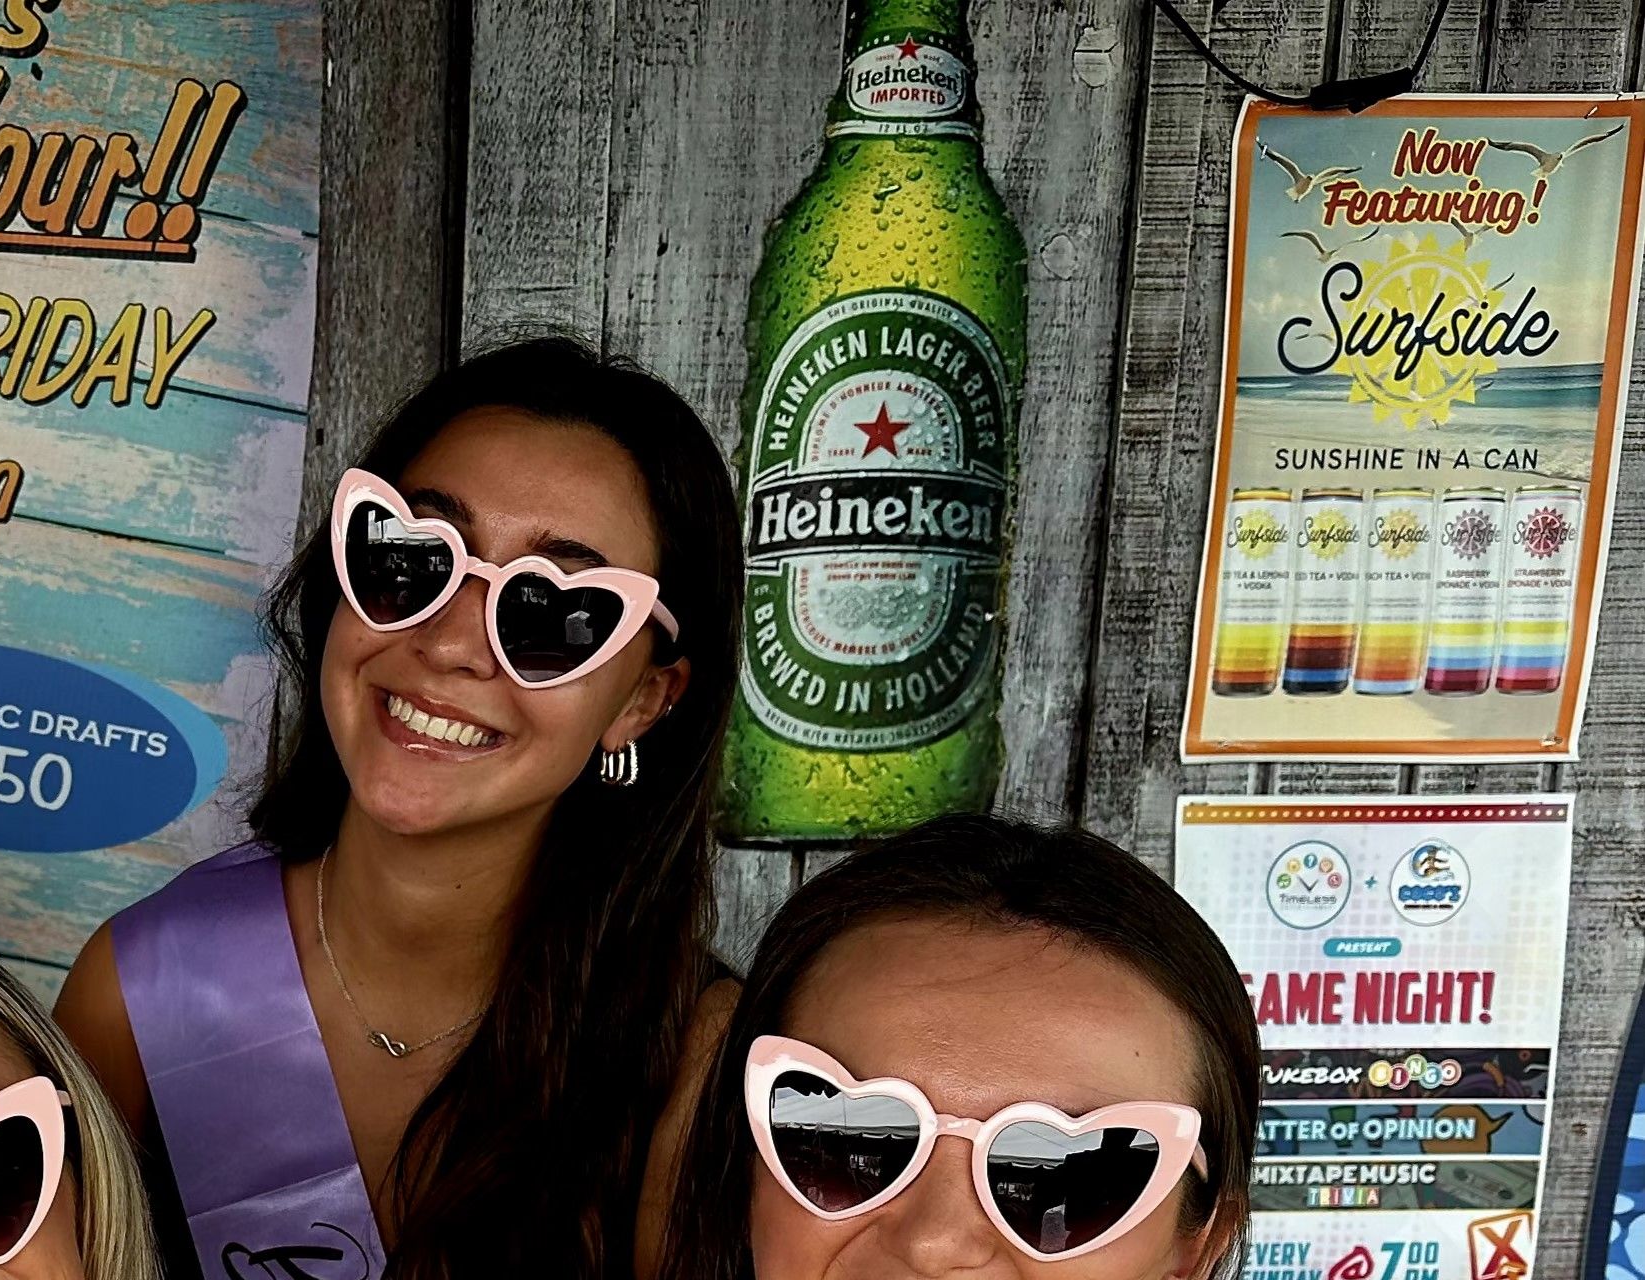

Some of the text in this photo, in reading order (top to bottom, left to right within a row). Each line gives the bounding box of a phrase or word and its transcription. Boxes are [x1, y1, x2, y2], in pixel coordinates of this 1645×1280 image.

[855, 63, 961, 96] Heineken
[870, 86, 947, 106] IMPORTED
[1393, 128, 1486, 178] Now
[1322, 179, 1547, 235] Featuring!
[1277, 261, 1560, 381] Surfside
[768, 326, 997, 451] HEINEKEN LAGER BEER
[1275, 448, 1539, 471] SUNSHINE IN A CAN
[757, 486, 995, 546] Heineken
[754, 602, 985, 713] BREWED IN HOLLAND
[28, 709, 169, 758] DRAFTS
[1354, 971, 1496, 1026] NIGHT!
[1362, 1118, 1477, 1140] OPINION
[1254, 1163, 1437, 1184] MIXTAPE MUSIC
[1308, 1187, 1379, 1207] TRIVIA
